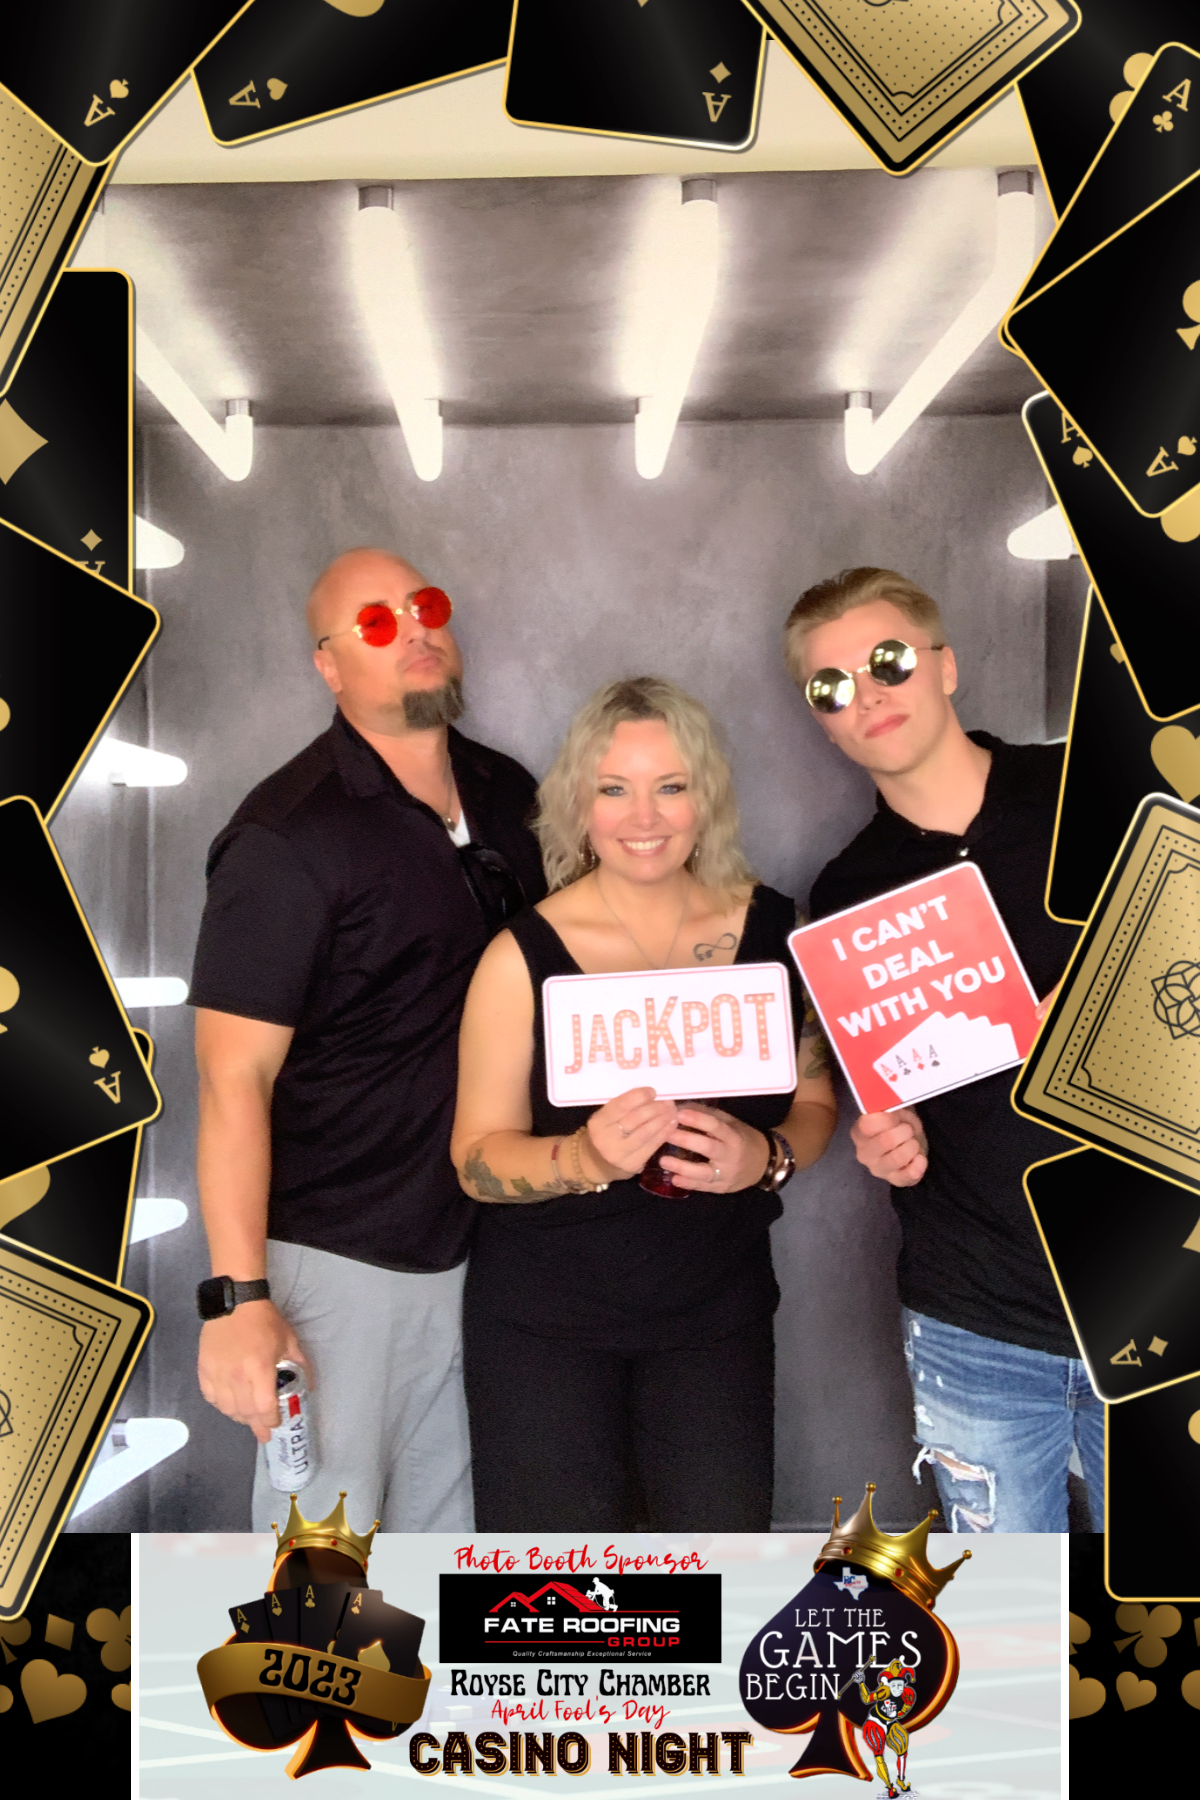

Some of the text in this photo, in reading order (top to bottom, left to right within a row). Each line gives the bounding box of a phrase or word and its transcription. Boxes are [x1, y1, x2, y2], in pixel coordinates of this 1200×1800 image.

[832, 894, 949, 962] I CAN'T
[861, 939, 955, 990] DEAL
[836, 955, 1006, 1038] WITH YOU
[563, 991, 776, 1075] JACKPOT
[912, 1047, 922, 1062] A
[929, 1044, 938, 1059] A
[879, 1063, 893, 1077] A
[895, 1054, 907, 1069] A
[290, 1417, 309, 1475] ULTRA
